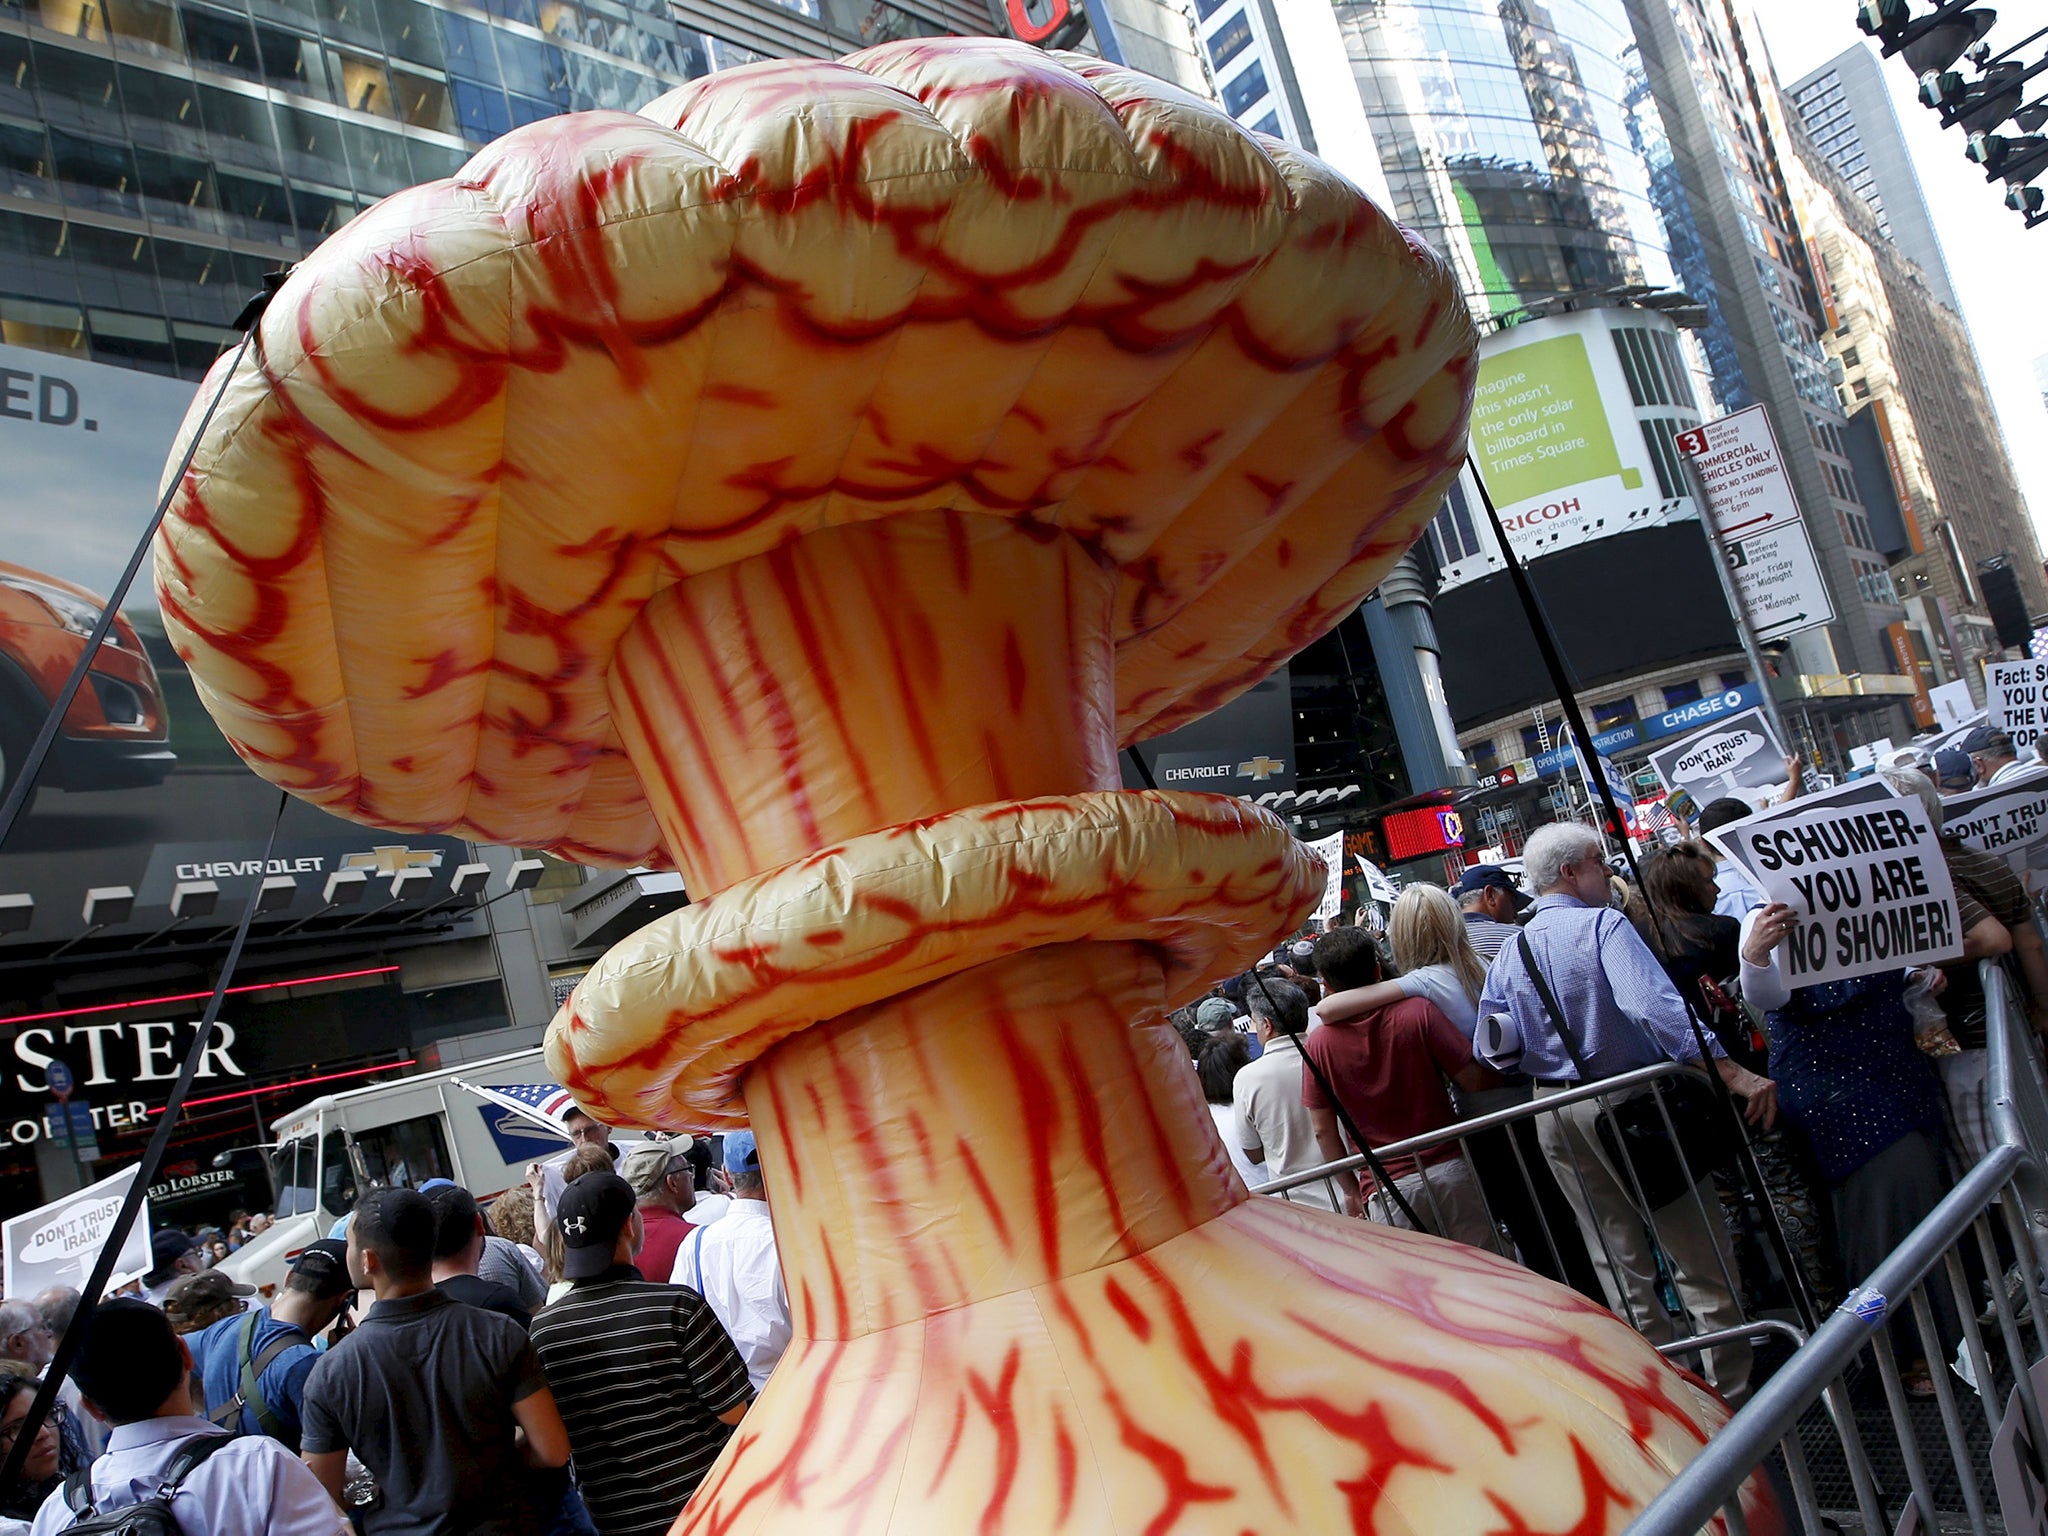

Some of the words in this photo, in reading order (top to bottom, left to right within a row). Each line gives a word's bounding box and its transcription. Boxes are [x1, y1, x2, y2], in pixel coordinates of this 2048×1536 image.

[0, 367, 98, 432] ED.
[1475, 400, 1501, 418] this
[1504, 384, 1552, 407] wasn't
[1481, 420, 1504, 437] the
[1508, 408, 1538, 427] only
[1542, 399, 1574, 417] solar
[1707, 425, 1723, 434] hour
[1485, 423, 1548, 455] billboard
[1552, 421, 1565, 433] in
[1684, 433, 1701, 455] 3
[1710, 426, 1740, 442] metered
[1712, 435, 1739, 450] parking
[1491, 452, 1534, 473] Times
[1536, 437, 1590, 459] Square.
[1696, 442, 1758, 472] OMMERCIAL
[1700, 461, 1743, 483] EHICLES
[1745, 449, 1771, 467] ONLY
[1704, 482, 1728, 496] THERS
[1729, 476, 1741, 487] NO
[1741, 464, 1779, 484] STANDING
[1710, 494, 1734, 510] onday
[1739, 485, 1764, 500] Friday
[1731, 500, 1750, 514] 6pm
[1501, 497, 1581, 532] RICOH
[1548, 515, 1588, 532] change.
[1745, 539, 1761, 548] hour
[1748, 541, 1778, 556] metered
[1750, 550, 1778, 565] parking
[1735, 570, 1760, 585] onday
[1767, 560, 1793, 574] Friday
[1757, 570, 1793, 588] Midnight
[1745, 593, 1773, 607] turday
[1765, 593, 1801, 610] Midnight
[1995, 667, 2030, 686] Fact:
[2035, 664, 2048, 681] S
[2003, 686, 2036, 706] YOU
[1663, 697, 1723, 728] CHASE
[2004, 708, 2035, 727] THE
[1537, 757, 1555, 770] OPEN
[1679, 749, 1711, 771] DON'T
[1715, 733, 1748, 755] TRUST
[1704, 752, 1735, 772] IRAN!
[1165, 765, 1231, 781] CHEVROLET
[2007, 798, 2048, 825] TRU
[1751, 809, 1926, 871] SCHUMER-
[1982, 819, 2038, 850] IRAN!
[176, 857, 324, 880] CHEVROLET
[1790, 867, 1861, 915] YOU
[1869, 856, 1929, 904] ARE
[1788, 921, 1827, 976] NO
[1836, 900, 1954, 967] SHOMER!
[148, 1183, 168, 1198] ED
[170, 1170, 235, 1192] LOBSTER
[36, 1220, 76, 1247] DON'T
[80, 1200, 120, 1229] TRUST
[63, 1226, 101, 1251] IRAN!
